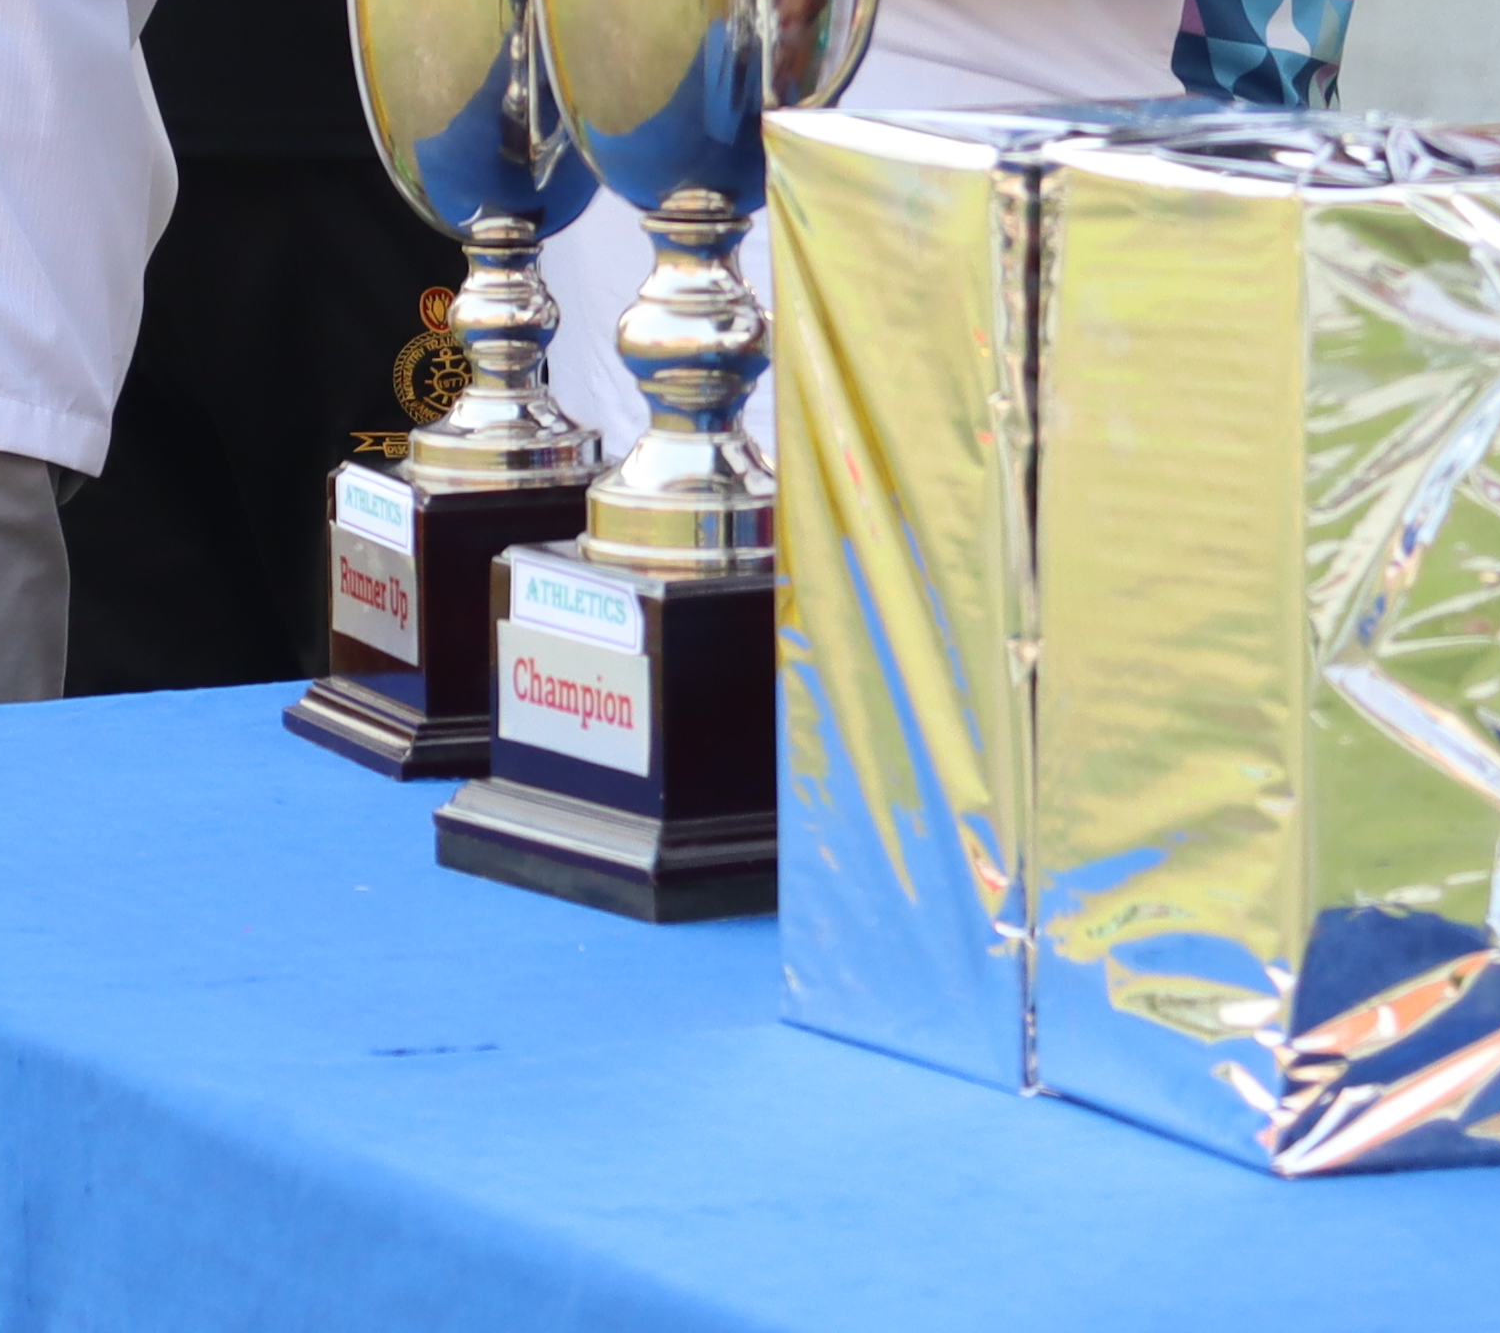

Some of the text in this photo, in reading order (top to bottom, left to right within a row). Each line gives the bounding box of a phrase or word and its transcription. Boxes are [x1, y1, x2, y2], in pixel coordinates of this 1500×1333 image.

[426, 336, 458, 351] TRAIN
[345, 483, 403, 526] ATHLETICS
[339, 555, 409, 631] Runner Up
[525, 576, 627, 626] ATHLETICS
[512, 655, 634, 731] Champion
